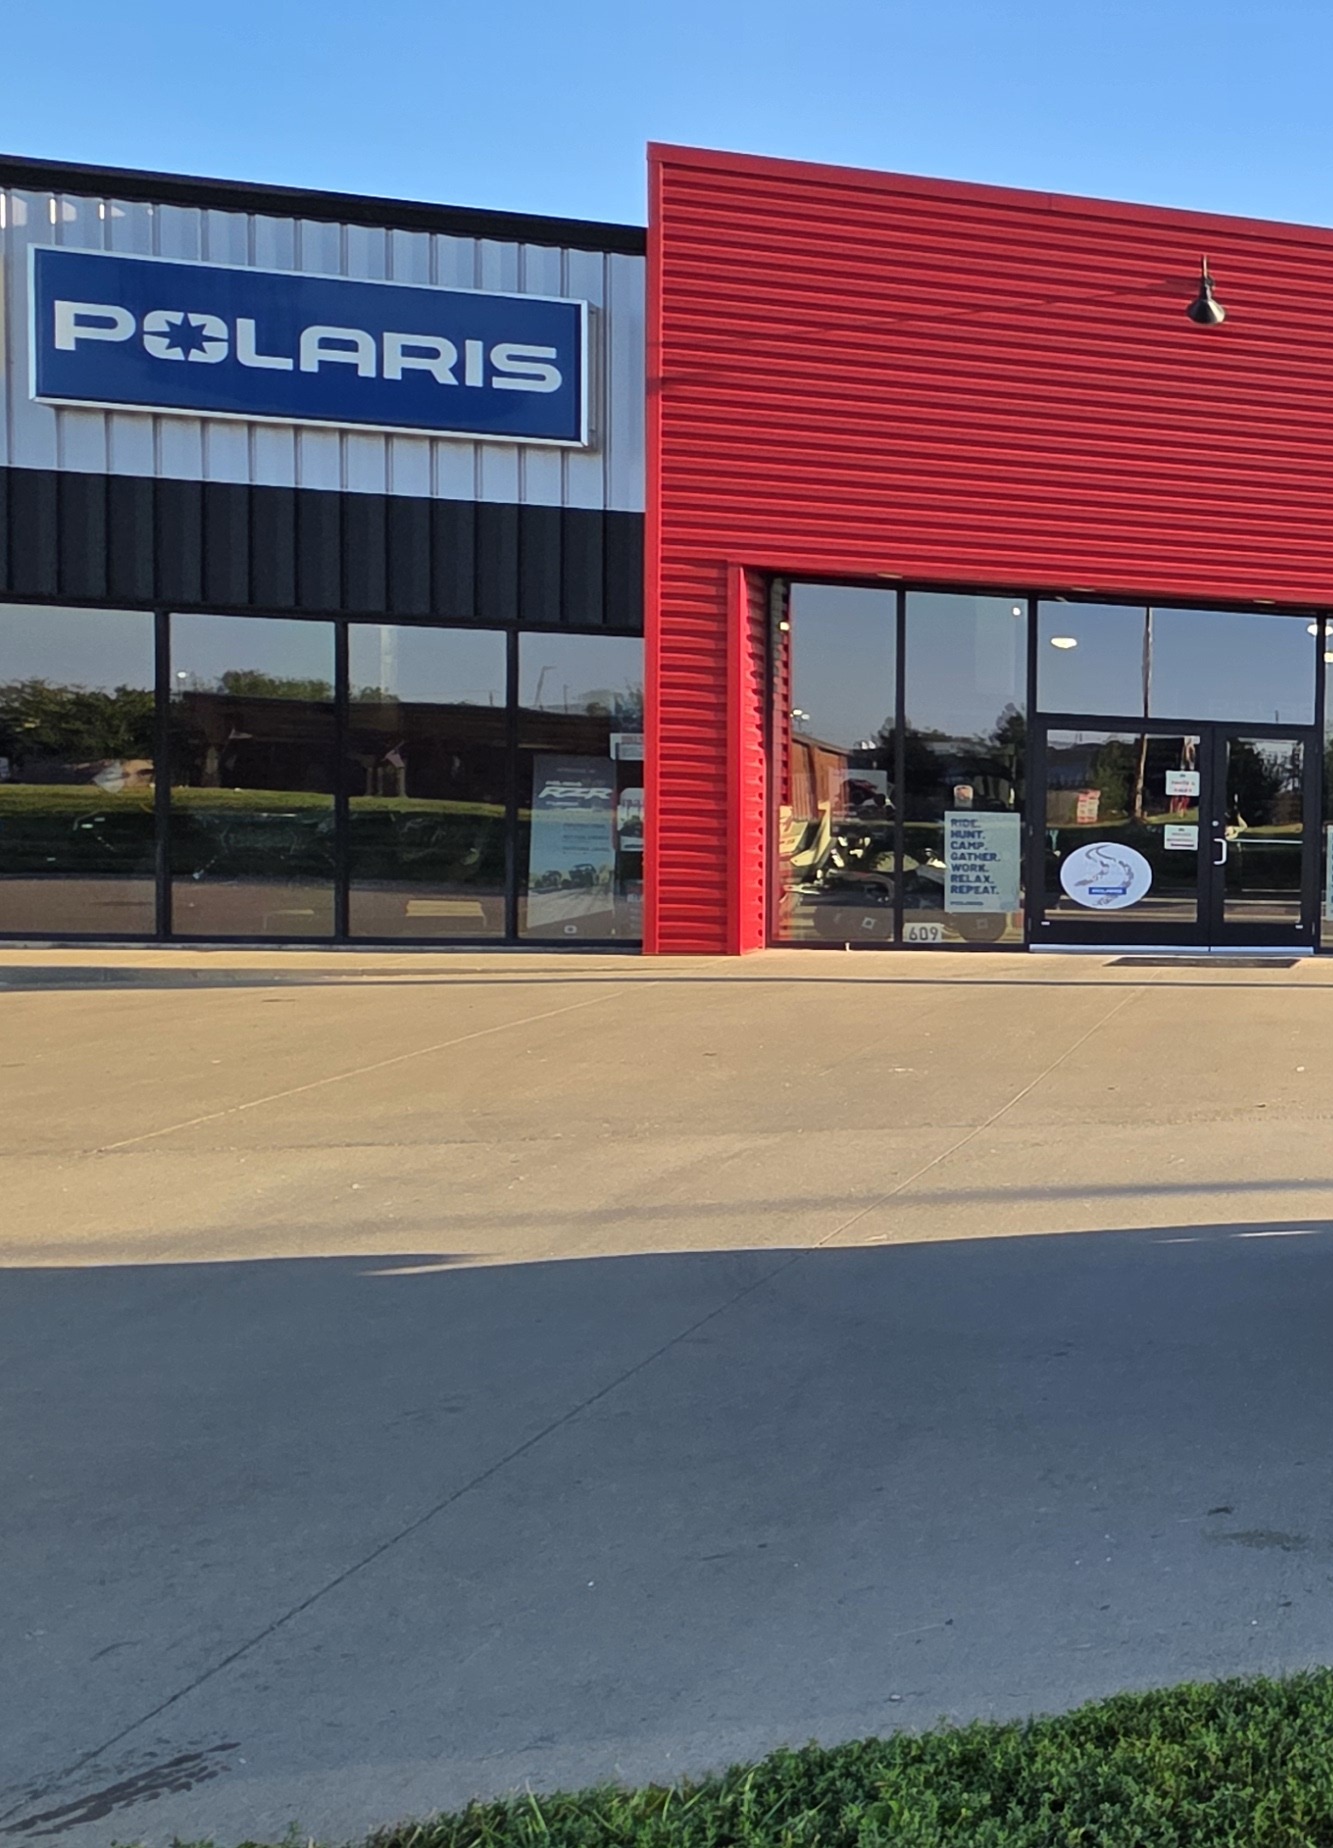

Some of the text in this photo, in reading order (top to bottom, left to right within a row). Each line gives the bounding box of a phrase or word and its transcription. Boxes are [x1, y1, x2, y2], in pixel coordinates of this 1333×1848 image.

[53, 299, 563, 394] POLARIS
[538, 786, 613, 799] RZR
[950, 818, 982, 829] RIDE.
[950, 830, 986, 840] HUNT.
[950, 841, 988, 851] CAMP.
[950, 852, 1001, 862] GATHER.
[950, 863, 990, 873] WORK.
[950, 874, 995, 884] RELAX.
[950, 885, 1000, 895] REPEAT.
[908, 925, 939, 941] 609
